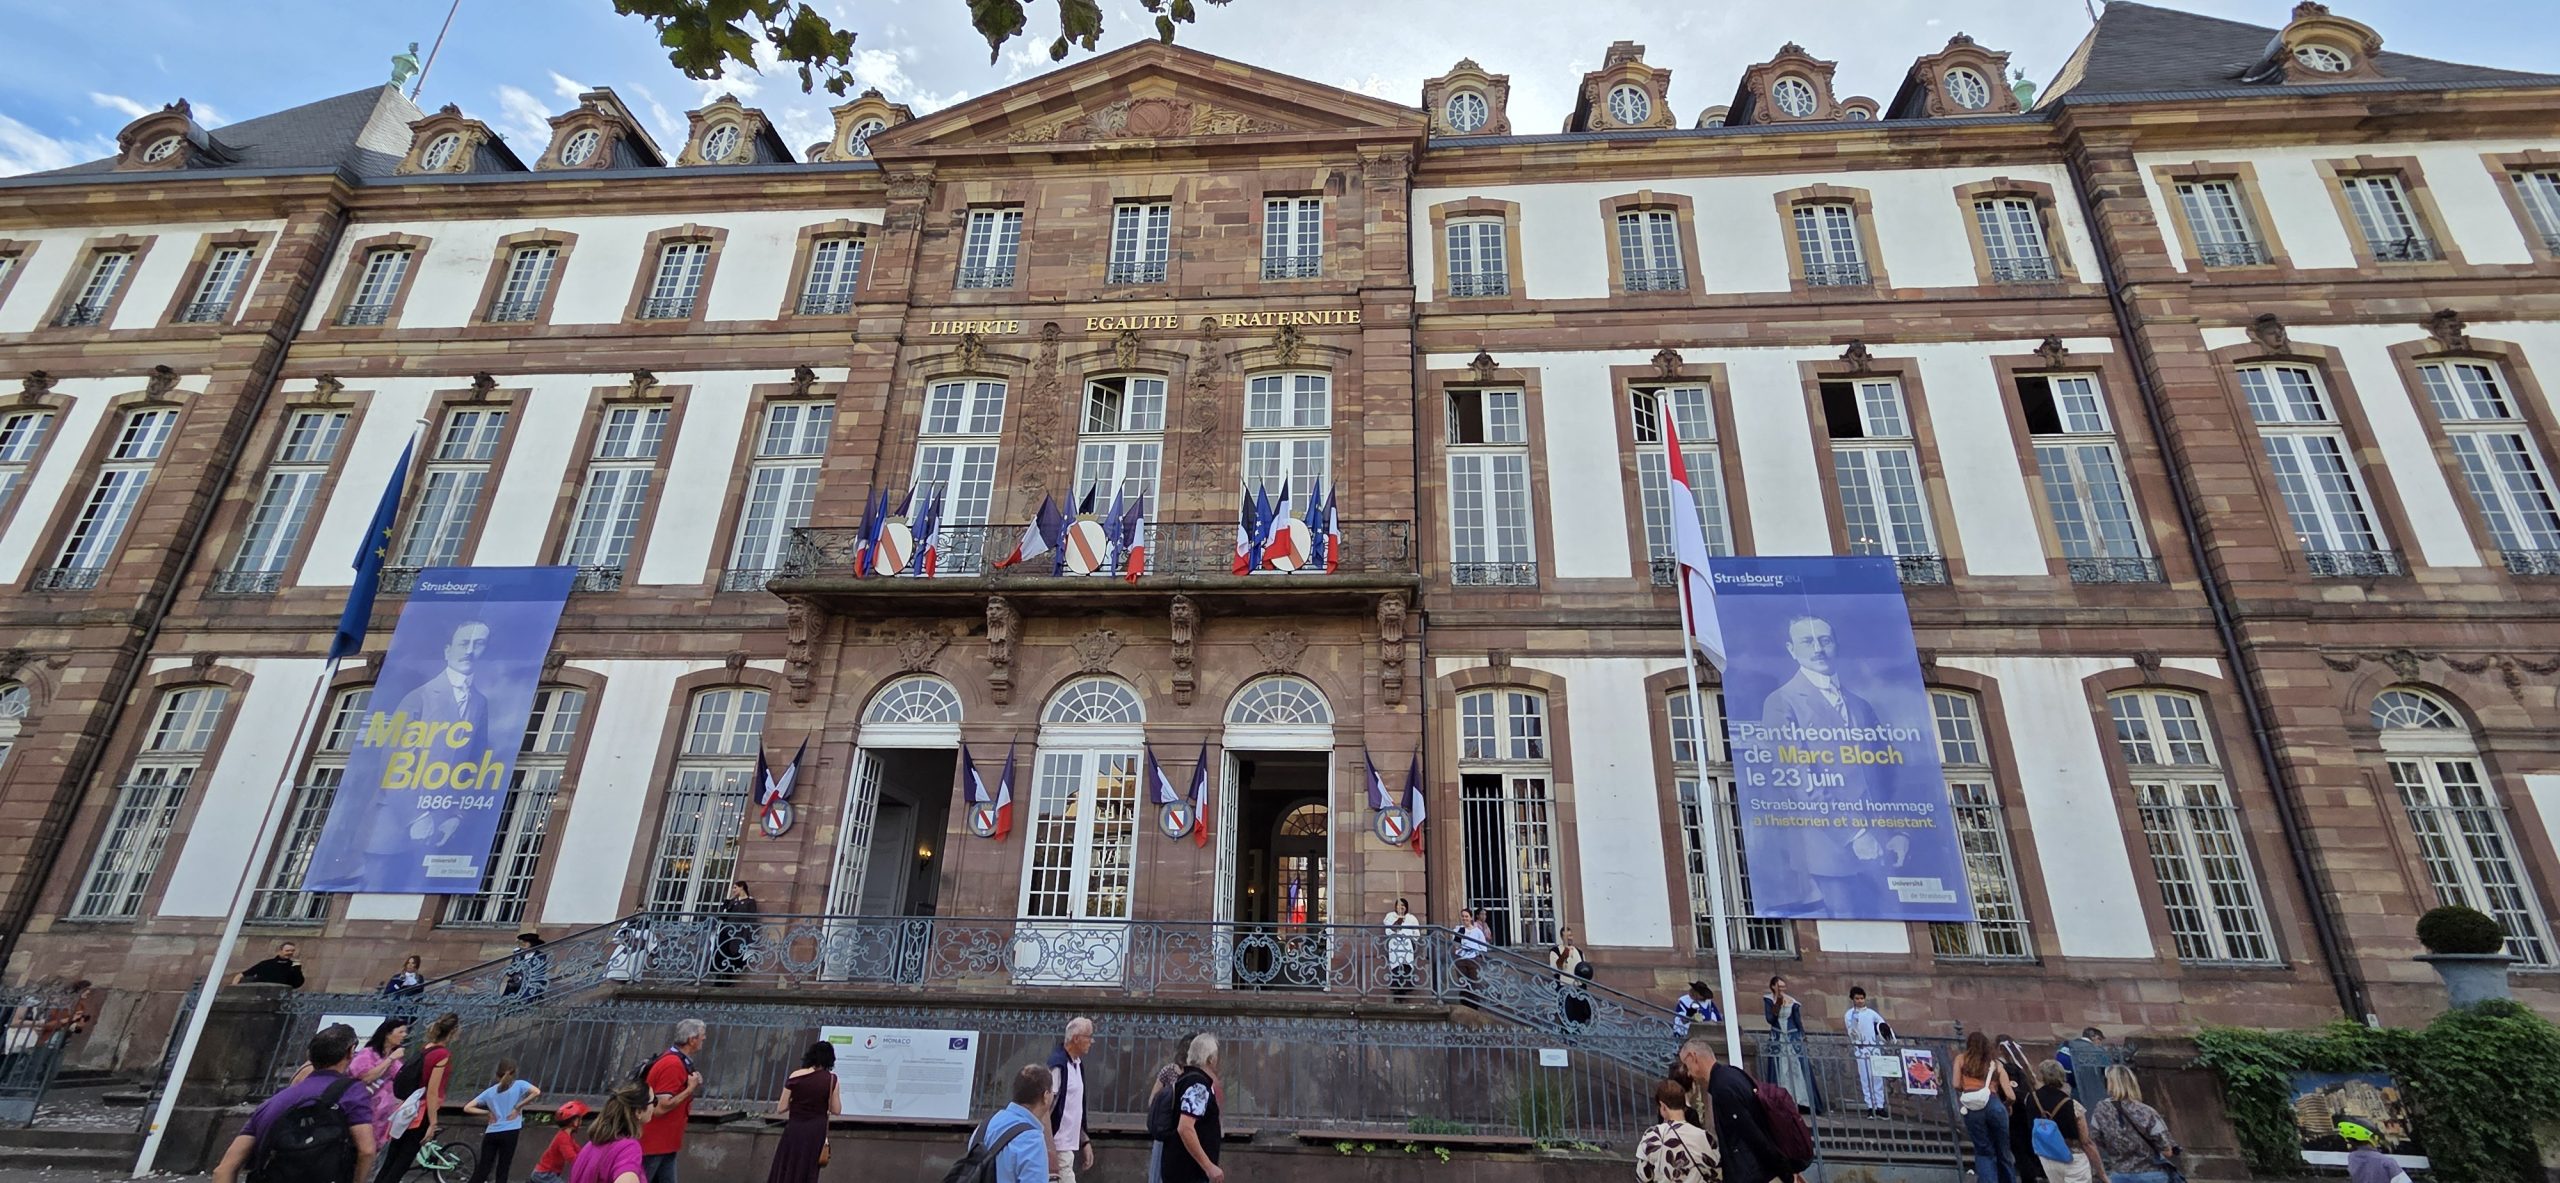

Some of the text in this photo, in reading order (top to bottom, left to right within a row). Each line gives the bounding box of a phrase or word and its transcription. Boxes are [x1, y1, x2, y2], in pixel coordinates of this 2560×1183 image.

[929, 310, 1362, 336] LIBERTE EGALITE FRATERNITE
[363, 711, 473, 749] Marc
[1738, 721, 1921, 742] Panthéonisation
[1743, 744, 1904, 765] de Marc Bloch
[380, 749, 505, 791] Bloch
[1746, 767, 1846, 793] le 23 juin
[416, 795, 496, 811] 1886-1944
[1751, 798, 1935, 815] Strasbourg rend hommage
[1764, 814, 1831, 827] l'historien
[1833, 815, 1849, 827] et
[1852, 817, 1869, 827] au
